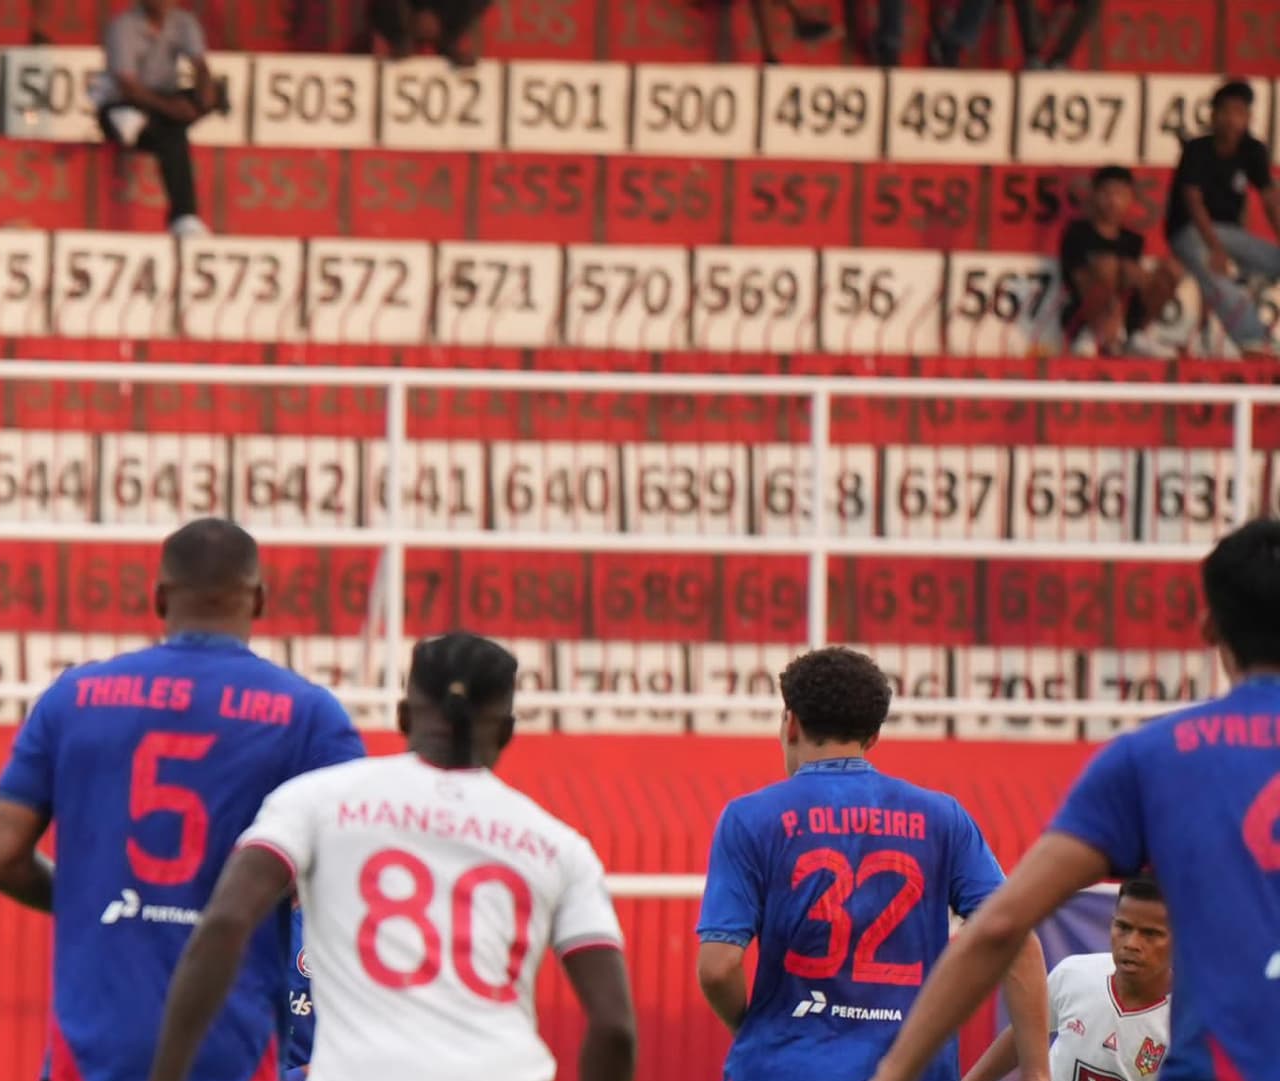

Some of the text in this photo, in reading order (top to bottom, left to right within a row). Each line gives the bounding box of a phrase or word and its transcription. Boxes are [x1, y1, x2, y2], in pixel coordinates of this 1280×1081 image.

[267, 73, 357, 125] 503
[393, 77, 483, 127] 502
[520, 80, 607, 132] 501
[647, 83, 737, 136] 500
[774, 86, 867, 138] 499
[899, 90, 992, 143] 498
[1030, 92, 1124, 145] 497
[235, 155, 330, 209] 553
[359, 157, 455, 211] 554
[490, 164, 584, 217] 555
[615, 165, 712, 223] 556
[749, 172, 840, 226] 557
[872, 174, 969, 228] 558
[62, 251, 158, 303] 574
[190, 252, 283, 302] 573
[317, 255, 410, 308] 572
[448, 260, 539, 311] 571
[581, 263, 669, 318] 570
[701, 263, 798, 318] 569
[964, 270, 1052, 321] 567
[112, 457, 219, 513] 643
[246, 460, 345, 515] 642
[504, 464, 610, 516] 640
[639, 465, 735, 519] 639
[897, 468, 994, 520] 637
[1025, 469, 1124, 521] 636
[76, 674, 293, 726] THALES LIRA
[126, 731, 218, 886] 5
[338, 800, 559, 863] MANSARAY
[808, 806, 926, 840] OLIVEIRA
[357, 847, 533, 1004] 80
[784, 847, 925, 986] 32
[831, 1004, 902, 1021] PERTAMINA
